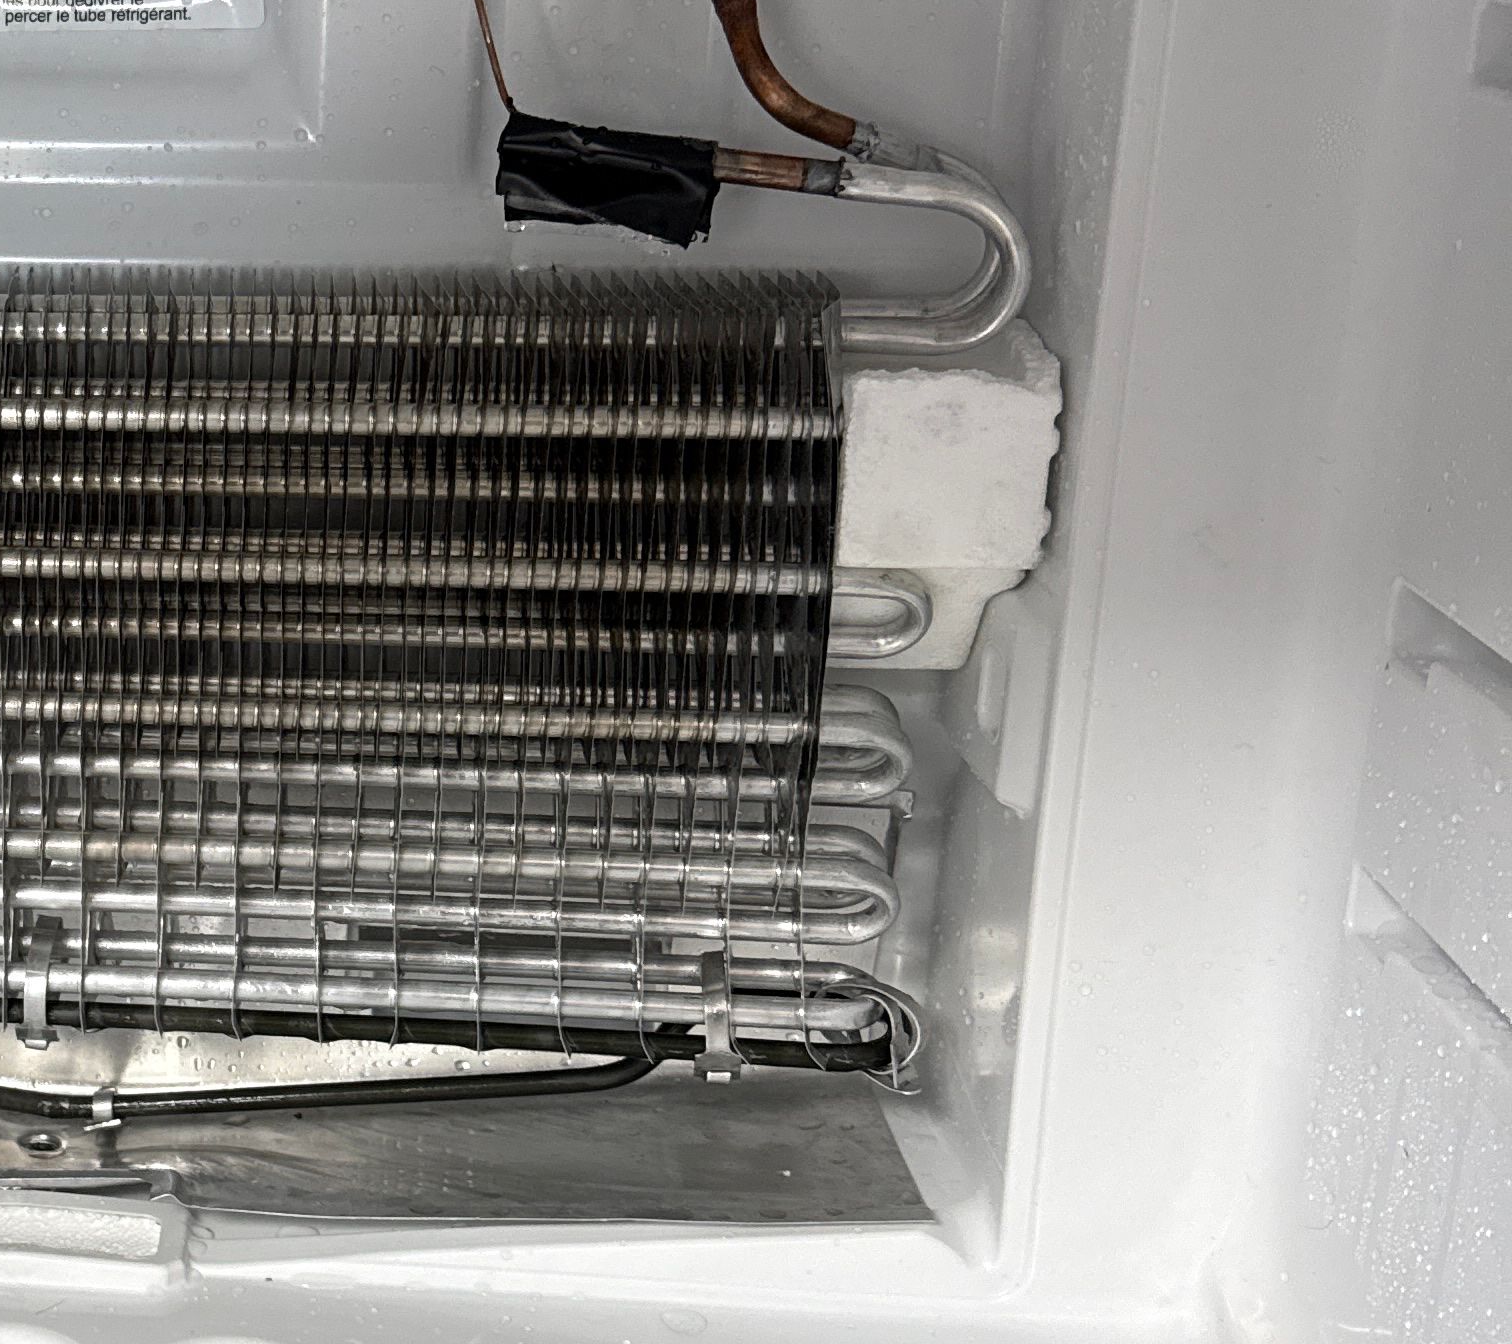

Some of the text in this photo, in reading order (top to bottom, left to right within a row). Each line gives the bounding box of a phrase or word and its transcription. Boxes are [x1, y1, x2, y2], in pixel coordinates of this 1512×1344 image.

[5, 10, 52, 26] percer
[57, 9, 70, 23] le
[74, 8, 106, 22] tube
